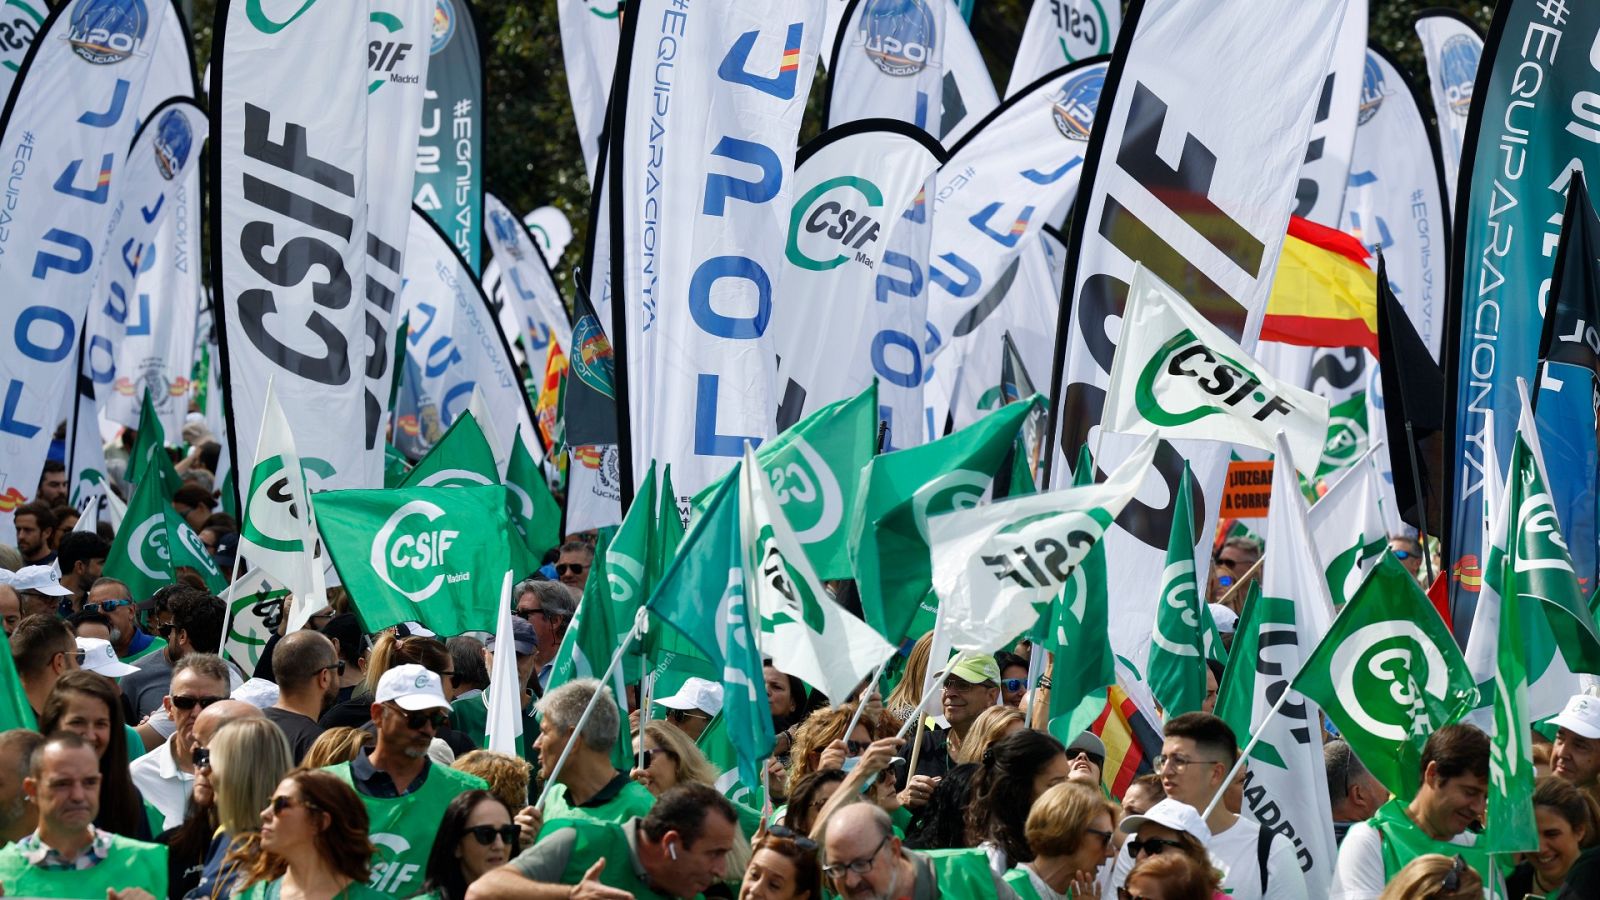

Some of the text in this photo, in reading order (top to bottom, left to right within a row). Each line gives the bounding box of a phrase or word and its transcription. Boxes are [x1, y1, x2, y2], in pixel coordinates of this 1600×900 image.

[368, 40, 413, 72] SIF
[390, 73, 419, 84] Madrid
[688, 22, 804, 457] UPOL
[806, 201, 881, 249] CSIF
[237, 102, 355, 386] CSIF
[1226, 493, 1233, 509] A
[390, 530, 460, 570] CSIF
[367, 862, 421, 894] SIF
